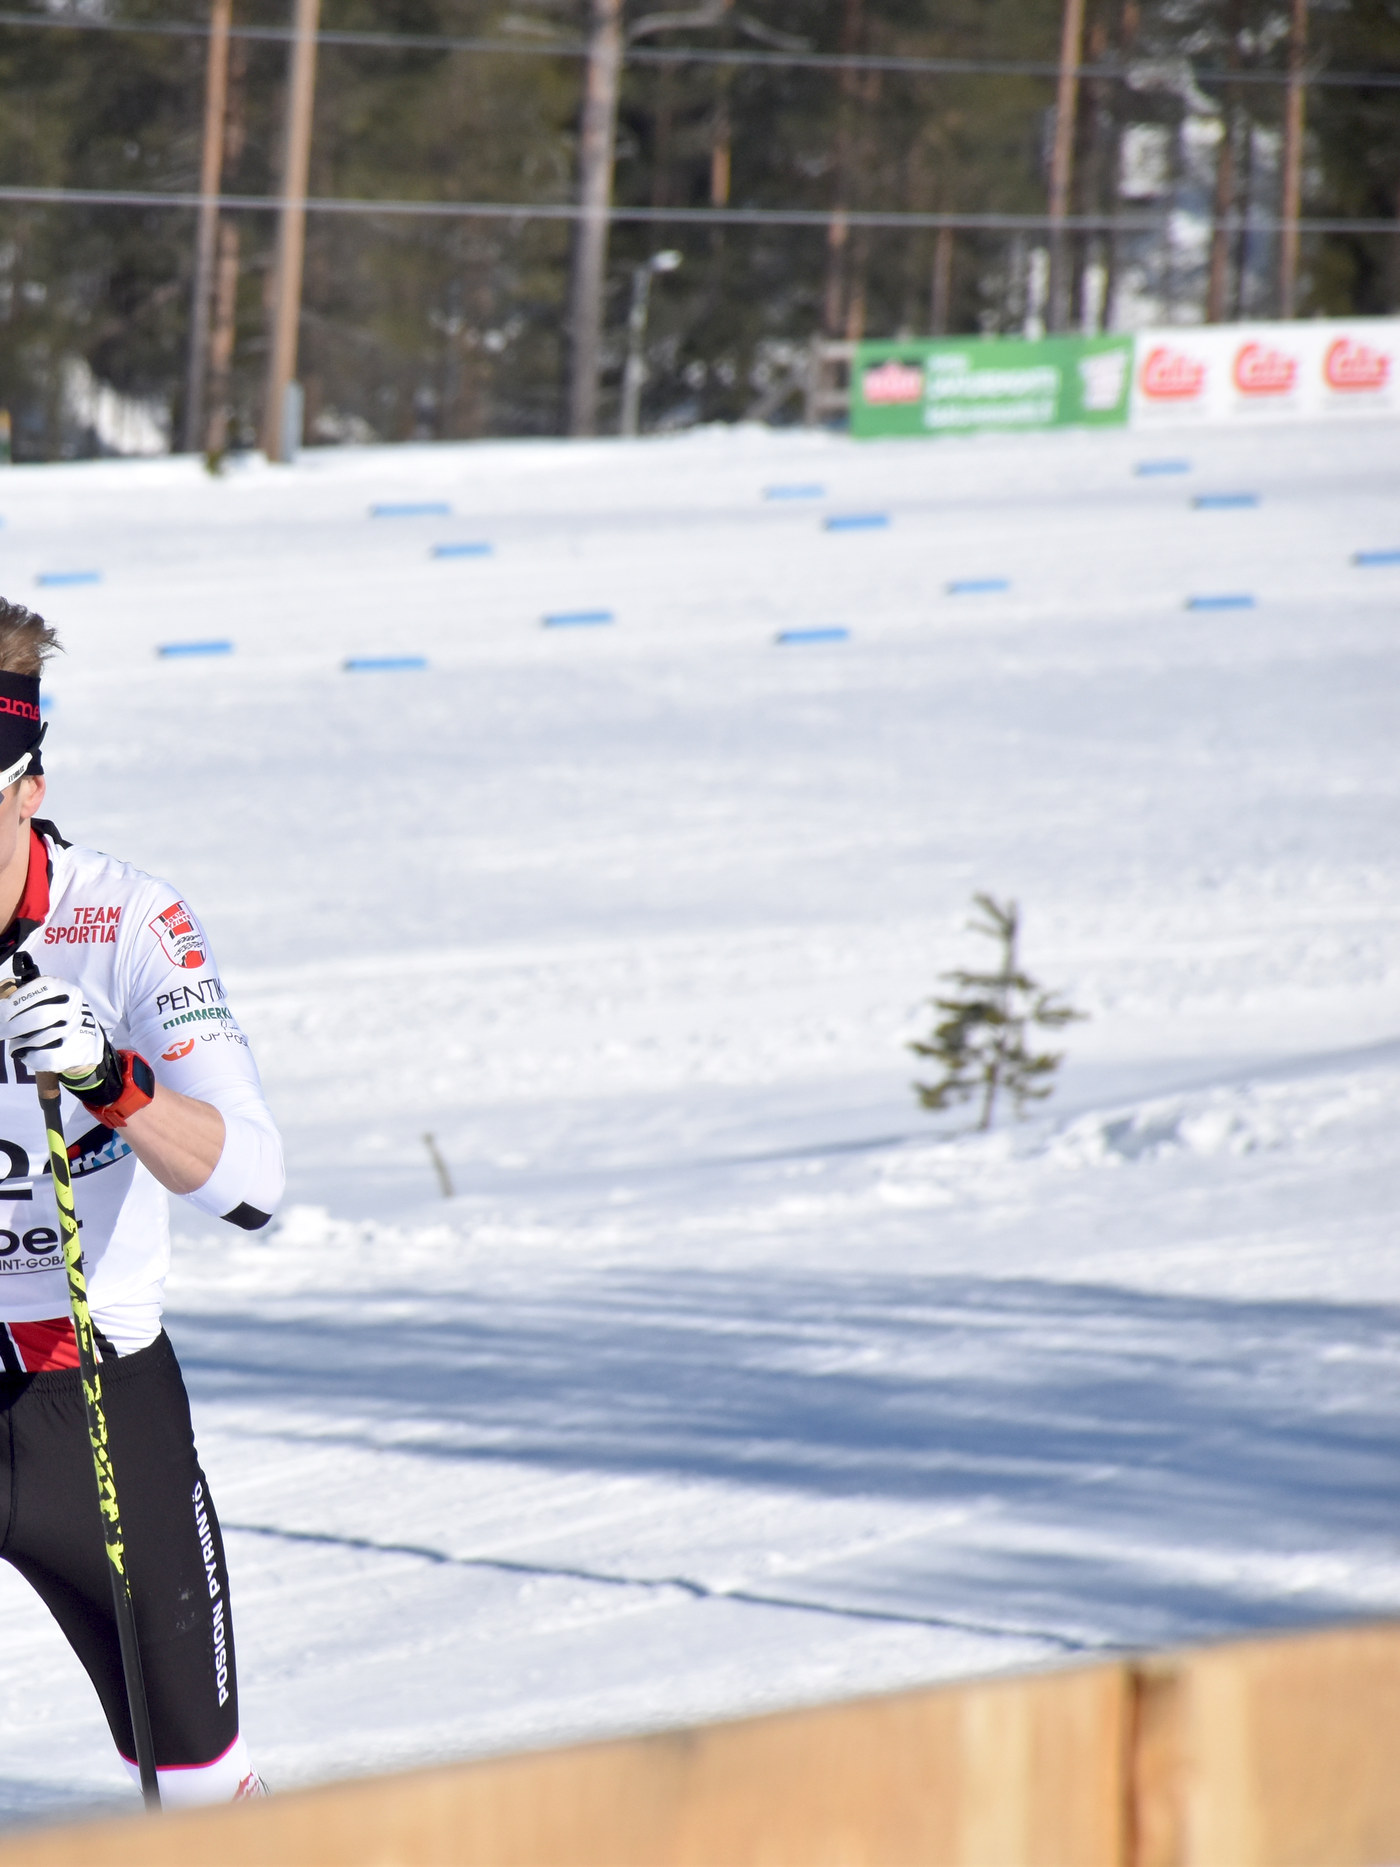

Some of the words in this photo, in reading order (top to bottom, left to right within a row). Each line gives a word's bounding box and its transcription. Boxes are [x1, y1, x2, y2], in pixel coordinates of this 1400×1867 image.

[43, 924, 118, 945] SPORTIA
[73, 906, 122, 925] TEAM
[192, 1479, 222, 1599] PYRINTÖ
[211, 1599, 229, 1708] POSION
